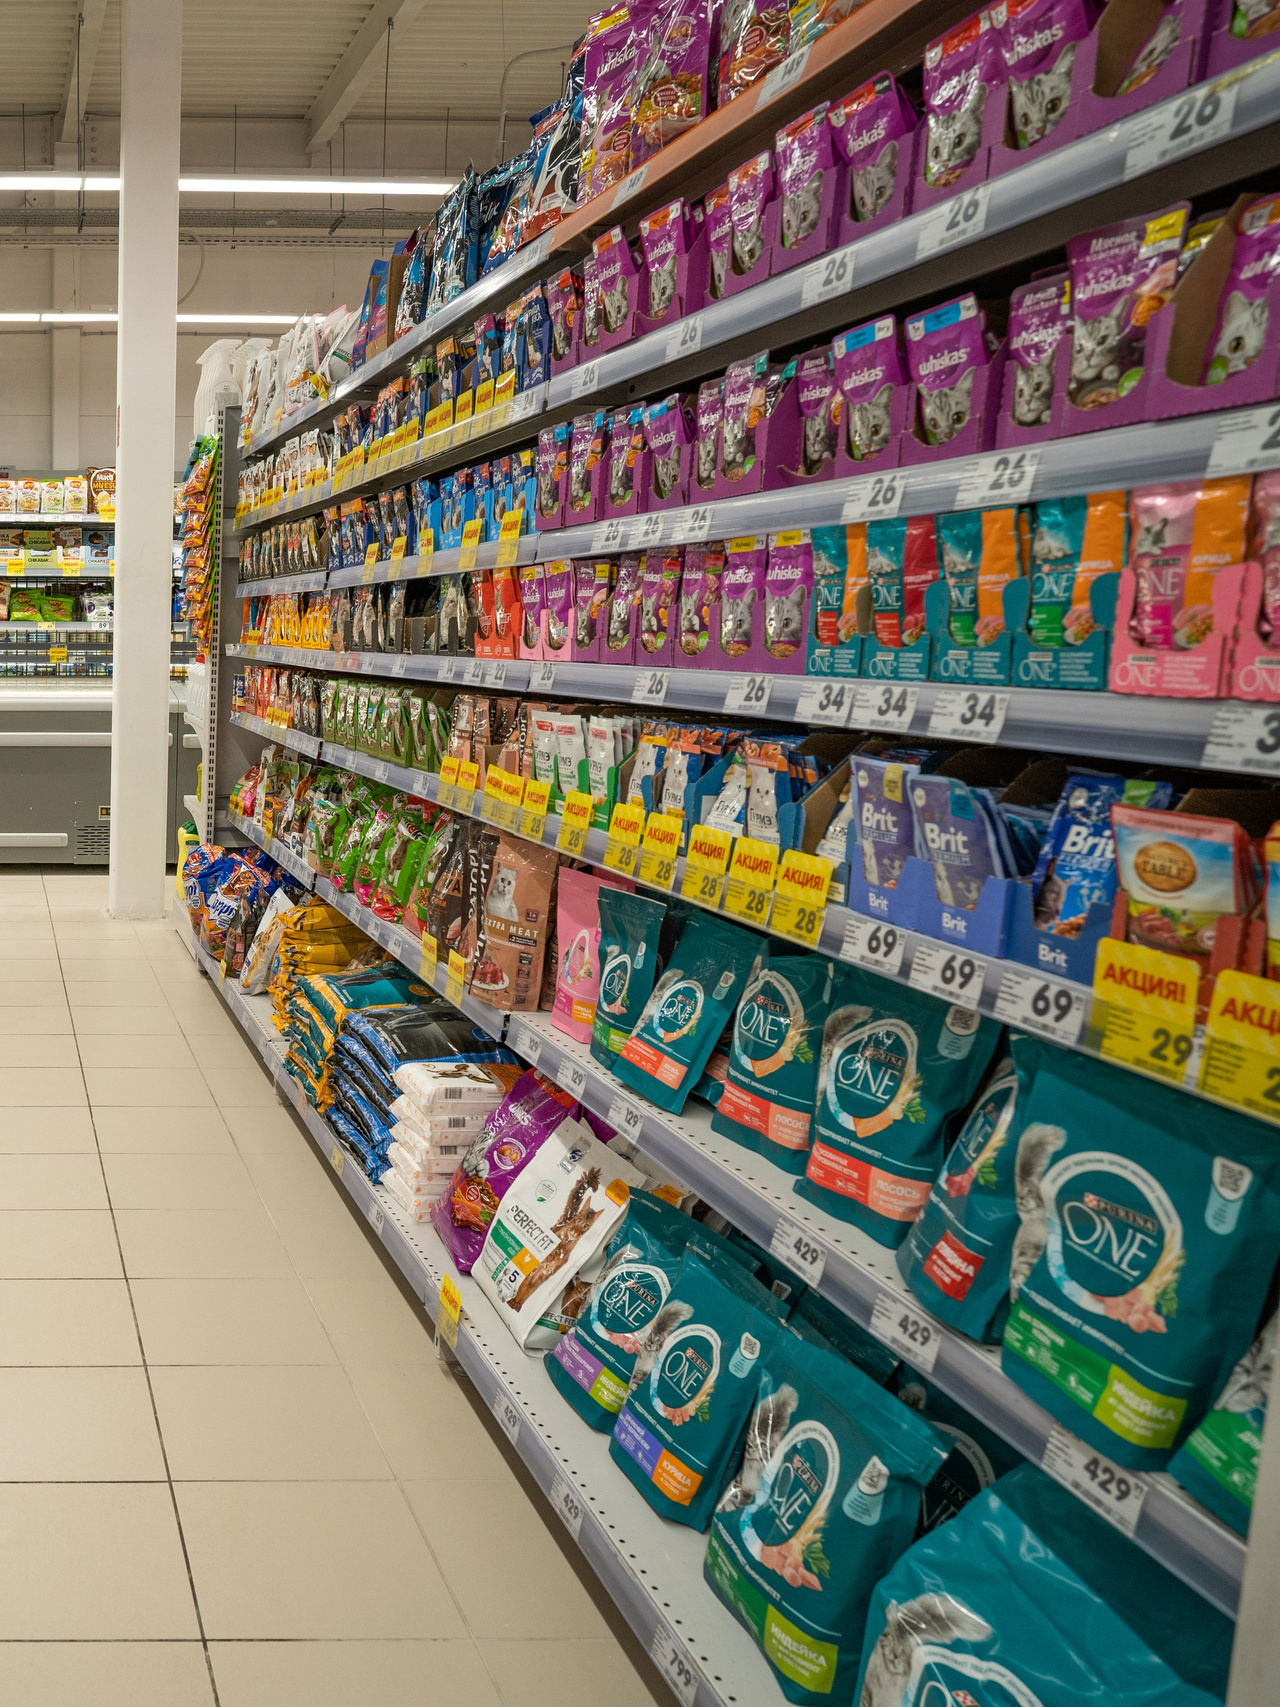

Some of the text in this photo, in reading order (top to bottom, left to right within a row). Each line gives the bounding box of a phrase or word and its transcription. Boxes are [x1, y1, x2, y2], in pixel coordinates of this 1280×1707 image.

[782, 59, 802, 83] 149
[1169, 94, 1221, 141] 26
[627, 176, 642, 193] 149
[945, 198, 981, 232] 26
[823, 251, 847, 287] 26
[1074, 273, 1136, 300] whiskas
[681, 317, 698, 346] 26
[919, 348, 970, 375] whiskas
[582, 368, 596, 387] 26
[843, 367, 884, 390] whiskas
[988, 455, 1027, 491] 26
[867, 475, 898, 508] 26
[502, 519, 519, 534] АКЦИЯ!
[604, 523, 620, 543] 26
[643, 516, 660, 538] 26
[688, 508, 708, 533] 26
[463, 528, 479, 541] АКЦИЯ!
[766, 567, 804, 582] whiskas
[1032, 572, 1073, 600] ONE
[547, 587, 567, 599] whiskas
[871, 584, 900, 607] ONE
[542, 664, 554, 681] 26
[808, 655, 833, 673] ONE
[870, 656, 897, 678] ONE
[939, 656, 972, 678] ONE
[1019, 659, 1057, 682] ONE
[1115, 661, 1161, 688] ONE
[647, 672, 665, 695] 26
[744, 677, 766, 702] 26
[820, 683, 846, 713] 34
[877, 686, 908, 718] 34
[960, 692, 997, 728] 34
[527, 790, 547, 806] АКЦИЯ!
[565, 803, 589, 819] АКЦИЯ!
[749, 808, 773, 827] ГУРМЭ
[862, 802, 898, 834] Brit
[531, 817, 541, 833] 28
[613, 816, 640, 835] АКЦИЯ!
[647, 827, 676, 846] АКЦИЯ!
[568, 830, 580, 848] 28
[691, 838, 726, 861] АКЦИЯ!
[924, 823, 969, 856] Brit
[618, 847, 632, 867] 28
[734, 853, 772, 876] АКЦИЯ!
[656, 860, 671, 882] 28
[782, 866, 825, 892] АКЦИЯ!
[702, 875, 717, 898] 28
[746, 889, 765, 914] 28
[868, 892, 890, 912] Brit
[484, 917, 539, 939] EXTRA MEAT
[795, 907, 816, 935] 28
[941, 913, 968, 934] Brit
[867, 925, 898, 958] 69
[1037, 943, 1069, 969] Brit
[941, 954, 976, 990] 69
[1102, 963, 1187, 1005] АКЦИЯ!
[1031, 983, 1073, 1023] 69
[740, 1007, 780, 1045] ONE
[529, 1036, 539, 1050] 129
[1150, 1027, 1194, 1066] 29
[572, 1068, 584, 1087] 129
[839, 1051, 895, 1101] ONE
[623, 1108, 639, 1128] 129
[875, 1178, 921, 1199] ЛОСОСЬ
[374, 1208, 384, 1226] 129
[506, 1203, 542, 1244] PERFECT
[538, 1231, 556, 1252] FIT
[1096, 1202, 1160, 1235] PURINA
[793, 1236, 819, 1266] 429
[1062, 1199, 1157, 1278] ONE
[507, 1269, 521, 1284] 5
[441, 1285, 459, 1314] АКЦИЯ!
[603, 1283, 652, 1328] ONE
[630, 1281, 659, 1306] PURINA
[898, 1314, 932, 1347] 429
[666, 1350, 704, 1397] ONE
[690, 1352, 711, 1374] PURINA
[503, 1407, 519, 1429] 429
[661, 1459, 692, 1488] КУРИЦА
[1083, 1456, 1132, 1503] 429
[563, 1494, 581, 1521] 429
[770, 1621, 828, 1668] ИНДЕЙКА
[669, 1648, 692, 1688] 799
